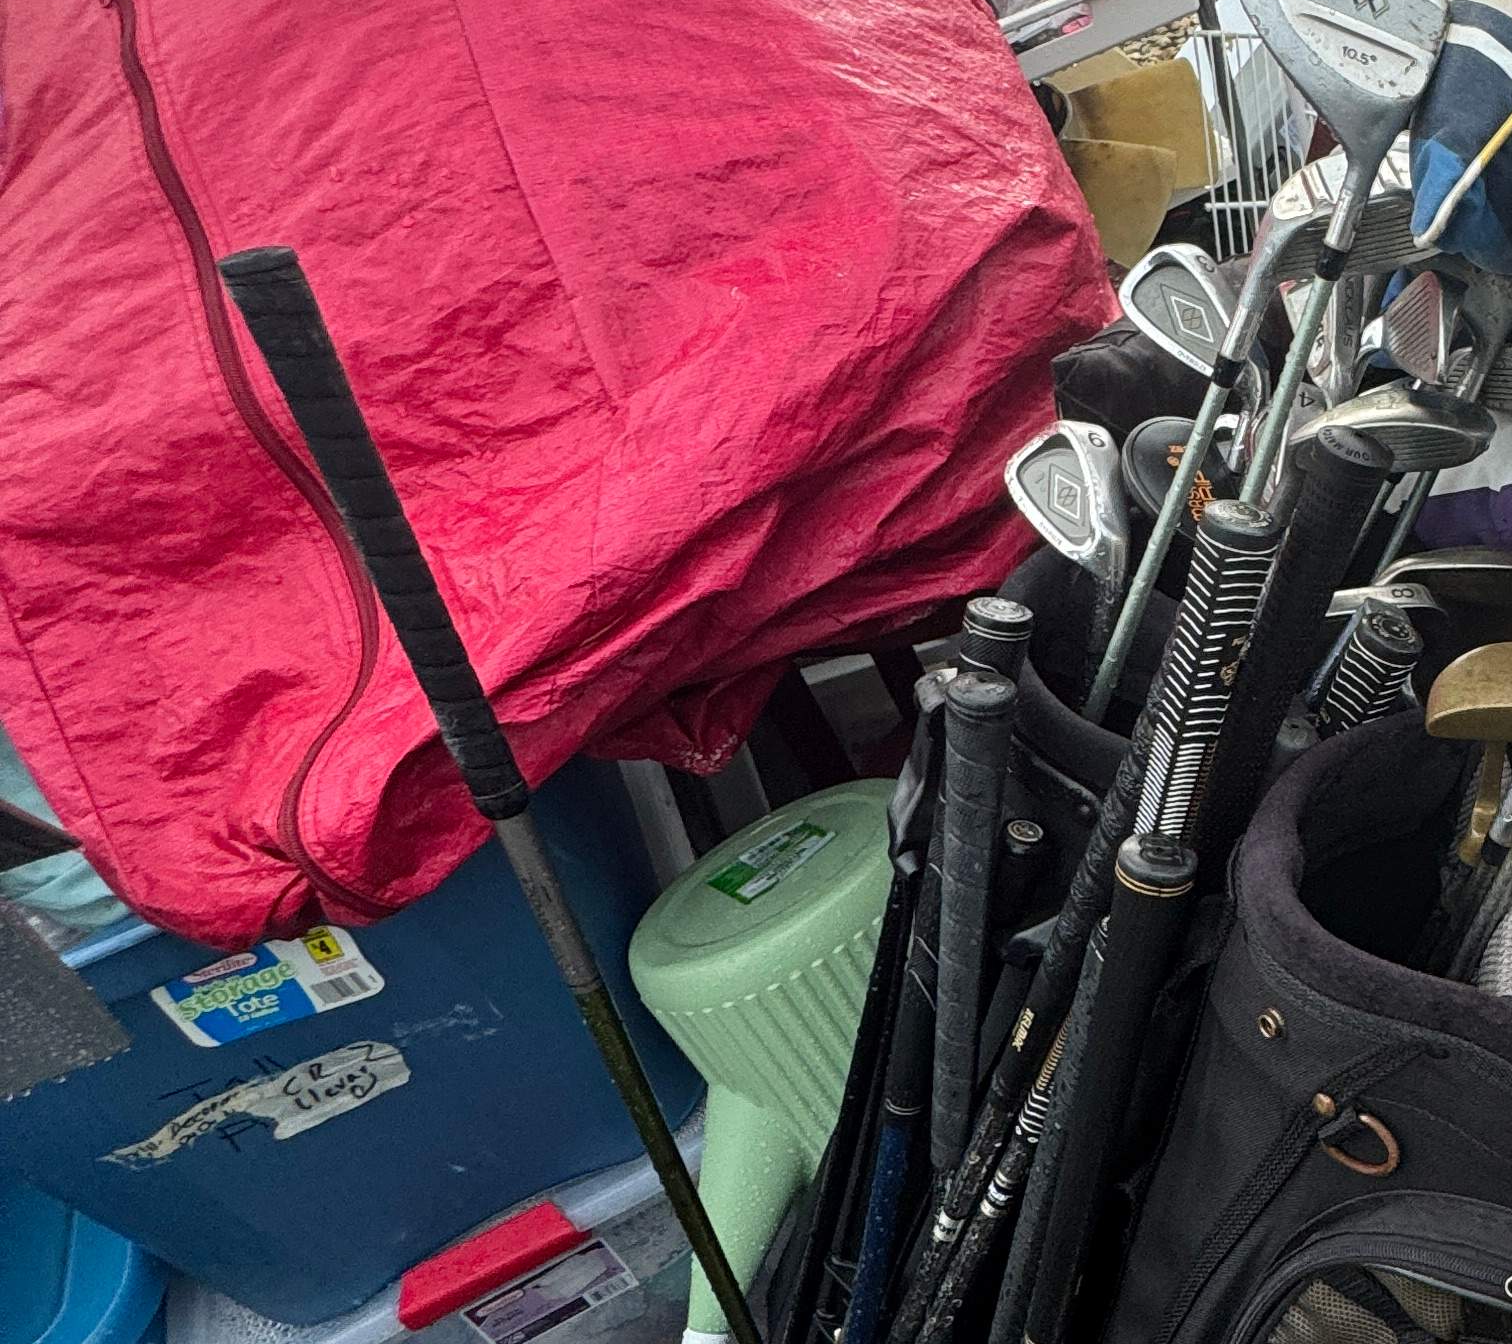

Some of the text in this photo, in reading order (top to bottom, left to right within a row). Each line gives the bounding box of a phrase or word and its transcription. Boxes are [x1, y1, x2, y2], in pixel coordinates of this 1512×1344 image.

[1391, 588, 1415, 599] 8
[174, 960, 298, 1023] storage
[226, 991, 281, 1018] Tote
